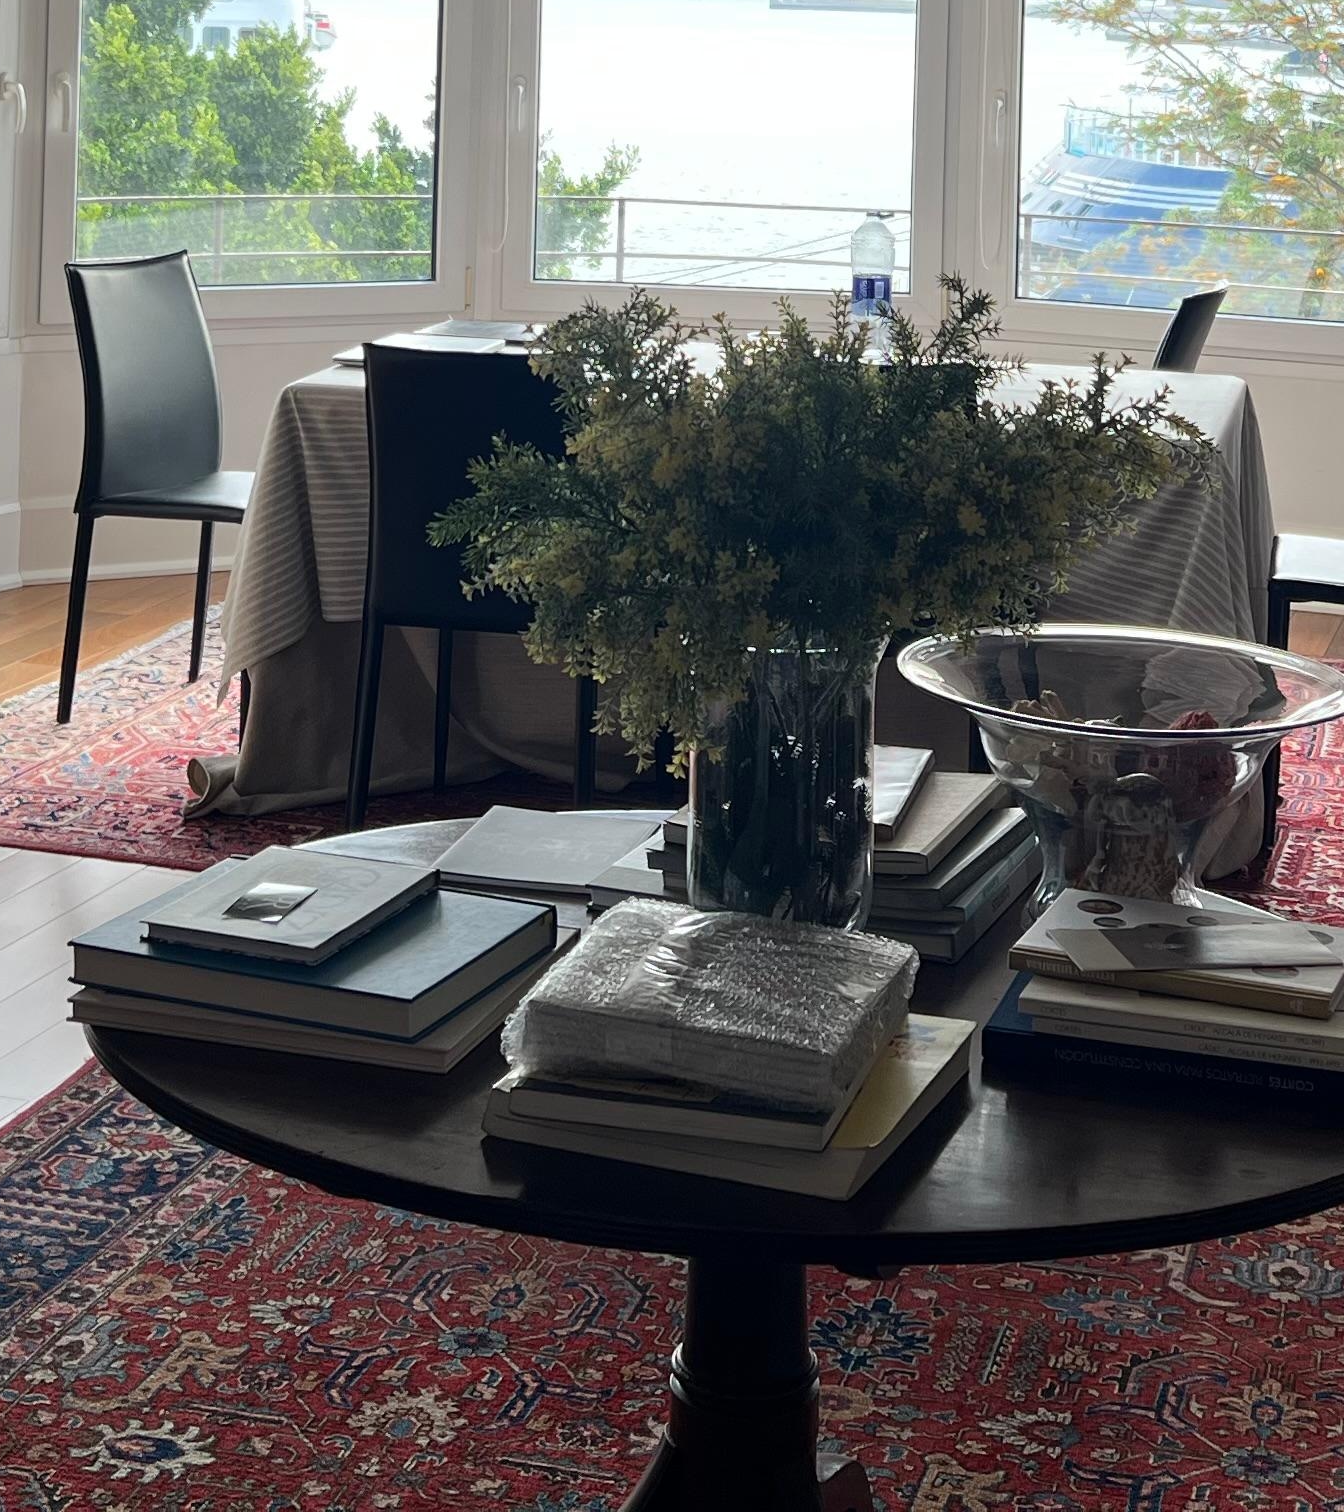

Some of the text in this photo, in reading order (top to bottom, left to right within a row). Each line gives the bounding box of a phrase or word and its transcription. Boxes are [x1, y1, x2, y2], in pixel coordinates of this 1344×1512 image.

[1144, 1059, 1171, 1073] UNA
[1174, 1064, 1204, 1078] PARA
[1205, 1067, 1264, 1087] RETRATOS
